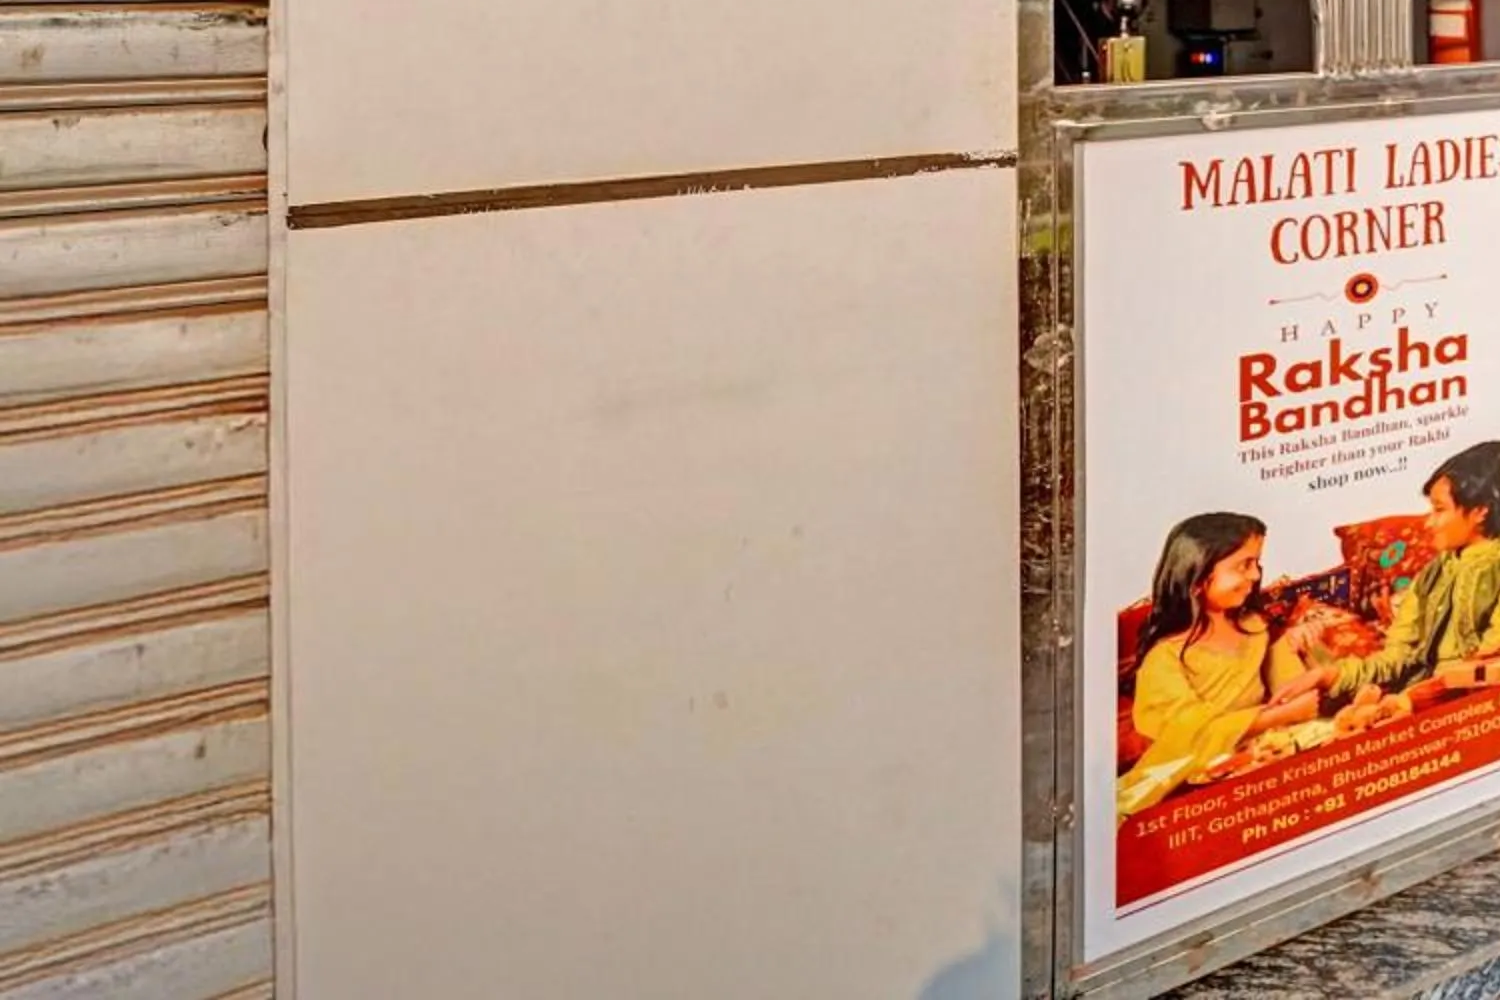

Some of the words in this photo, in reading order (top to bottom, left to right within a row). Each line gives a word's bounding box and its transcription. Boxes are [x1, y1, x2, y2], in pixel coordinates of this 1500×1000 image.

[1178, 147, 1358, 211] MALATI
[1270, 200, 1447, 265] CORNER
[1279, 301, 1440, 343] HAPPY
[1238, 326, 1469, 403] Raksha
[1238, 448, 1275, 464] This
[1280, 433, 1337, 456] Raksha
[1342, 420, 1413, 441] Bandhan,
[1416, 403, 1470, 428] sparkle
[1239, 372, 1468, 442] Bandhan
[1260, 456, 1328, 481] brighter
[1331, 448, 1366, 465] than
[1368, 440, 1404, 463] your
[1408, 427, 1451, 447] Rakhi
[1307, 470, 1350, 491] shop
[1136, 815, 1168, 837] 1st
[1173, 794, 1229, 824] Floor,
[1232, 776, 1278, 801] Shre
[1282, 749, 1351, 784] Krishna
[1355, 725, 1416, 757] Market
[1168, 825, 1203, 850] IIIT,
[1208, 782, 1328, 834] Gothapatna,
[1241, 822, 1267, 845] Ph
[1272, 810, 1300, 833] No
[1314, 793, 1347, 814] +91
